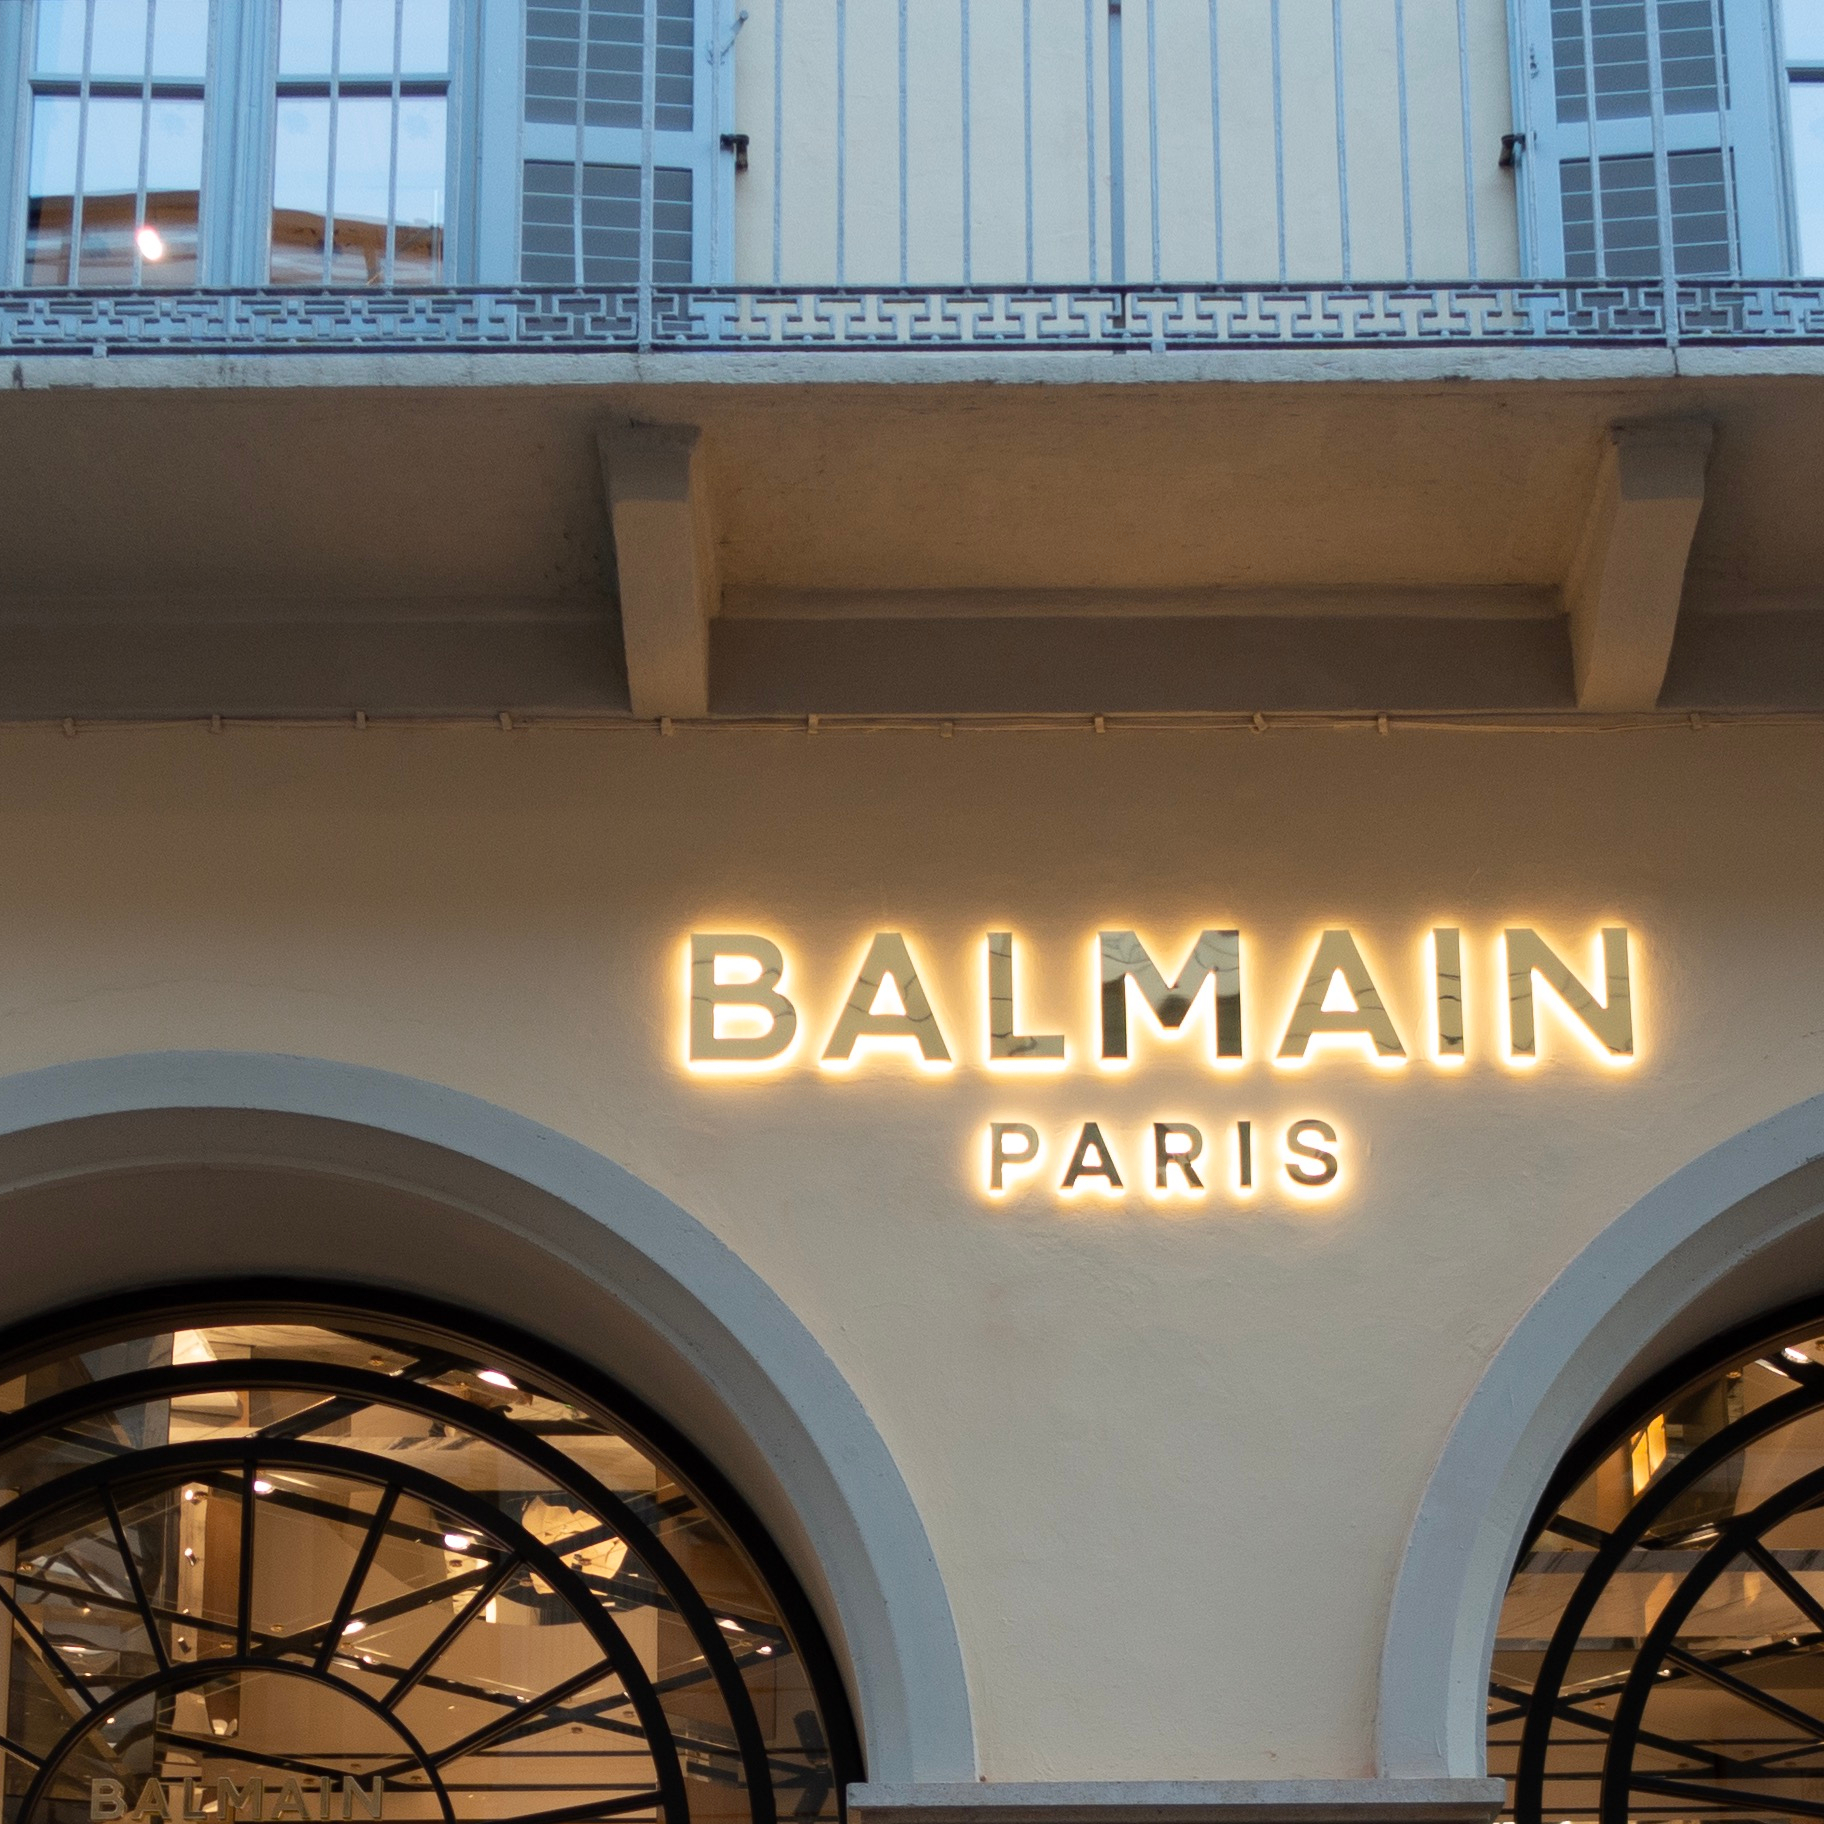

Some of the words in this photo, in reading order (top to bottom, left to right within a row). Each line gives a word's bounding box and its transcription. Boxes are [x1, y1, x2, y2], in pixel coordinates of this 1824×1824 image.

[688, 926, 1636, 1066] BALMAIN
[988, 1118, 1341, 1195] PARIS
[89, 1775, 385, 1822] BALMAIN
